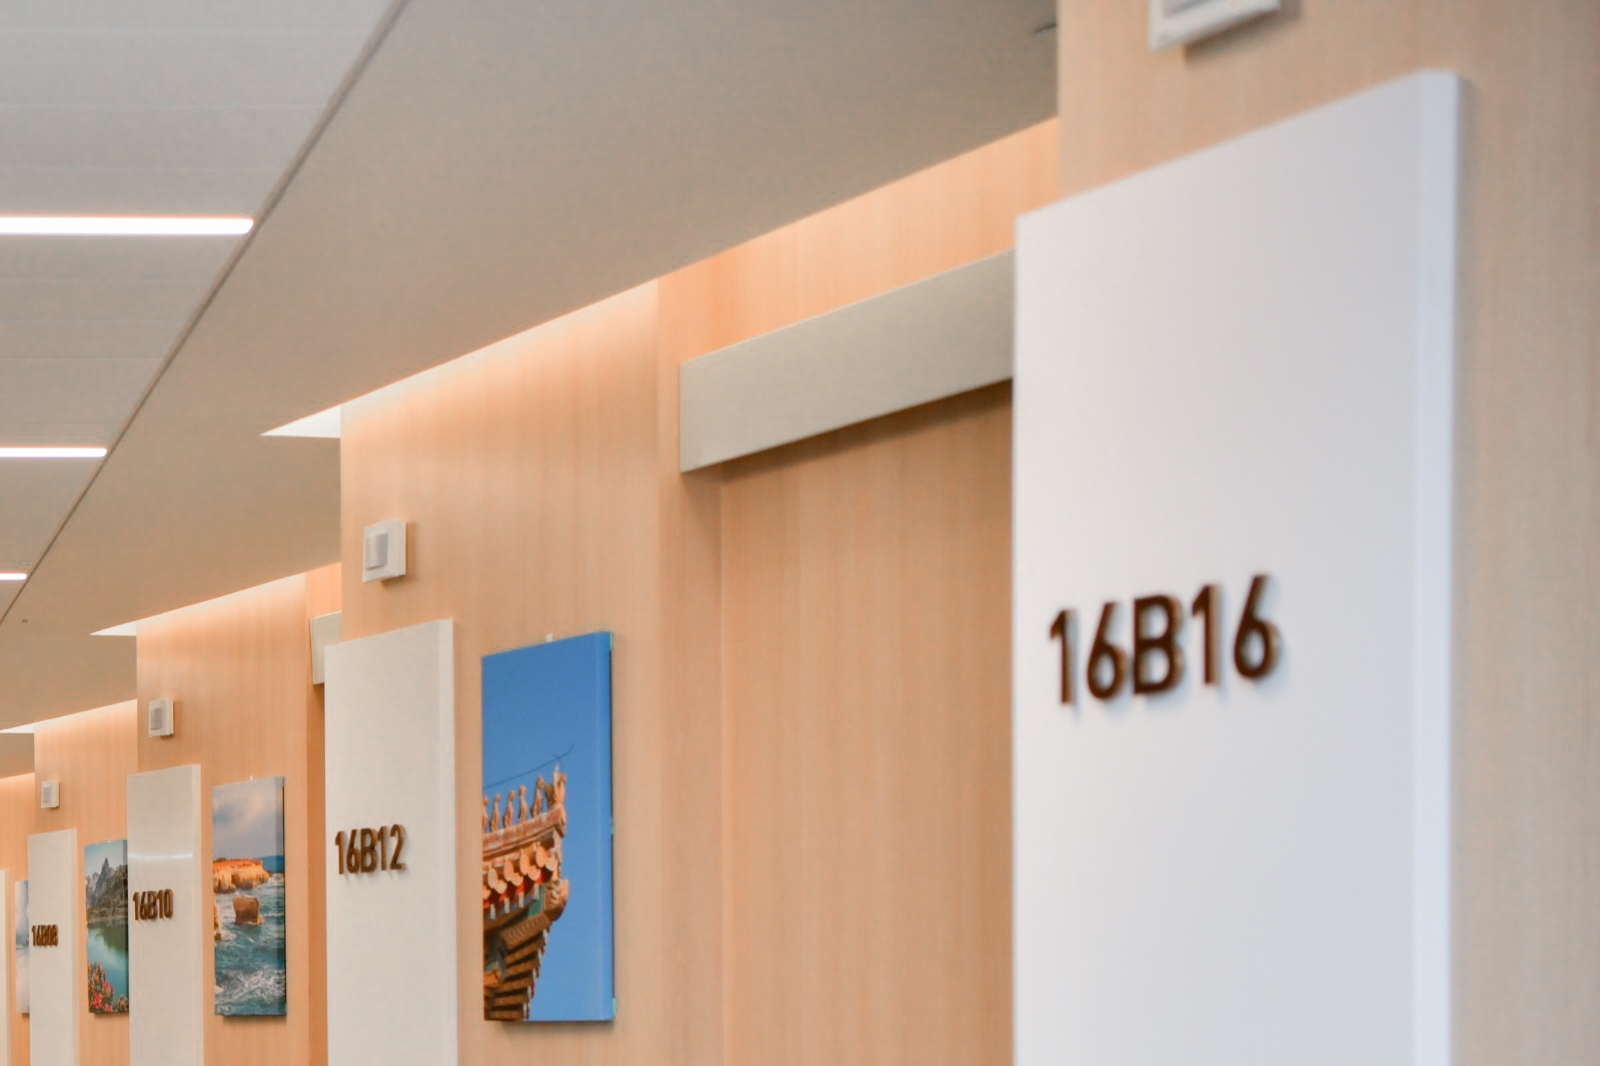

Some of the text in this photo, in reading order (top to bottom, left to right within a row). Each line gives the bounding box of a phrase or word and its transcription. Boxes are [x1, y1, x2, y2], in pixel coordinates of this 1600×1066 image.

[1049, 573, 1281, 705] 16B16
[335, 823, 406, 875] 16B12
[132, 888, 174, 921] 16B10
